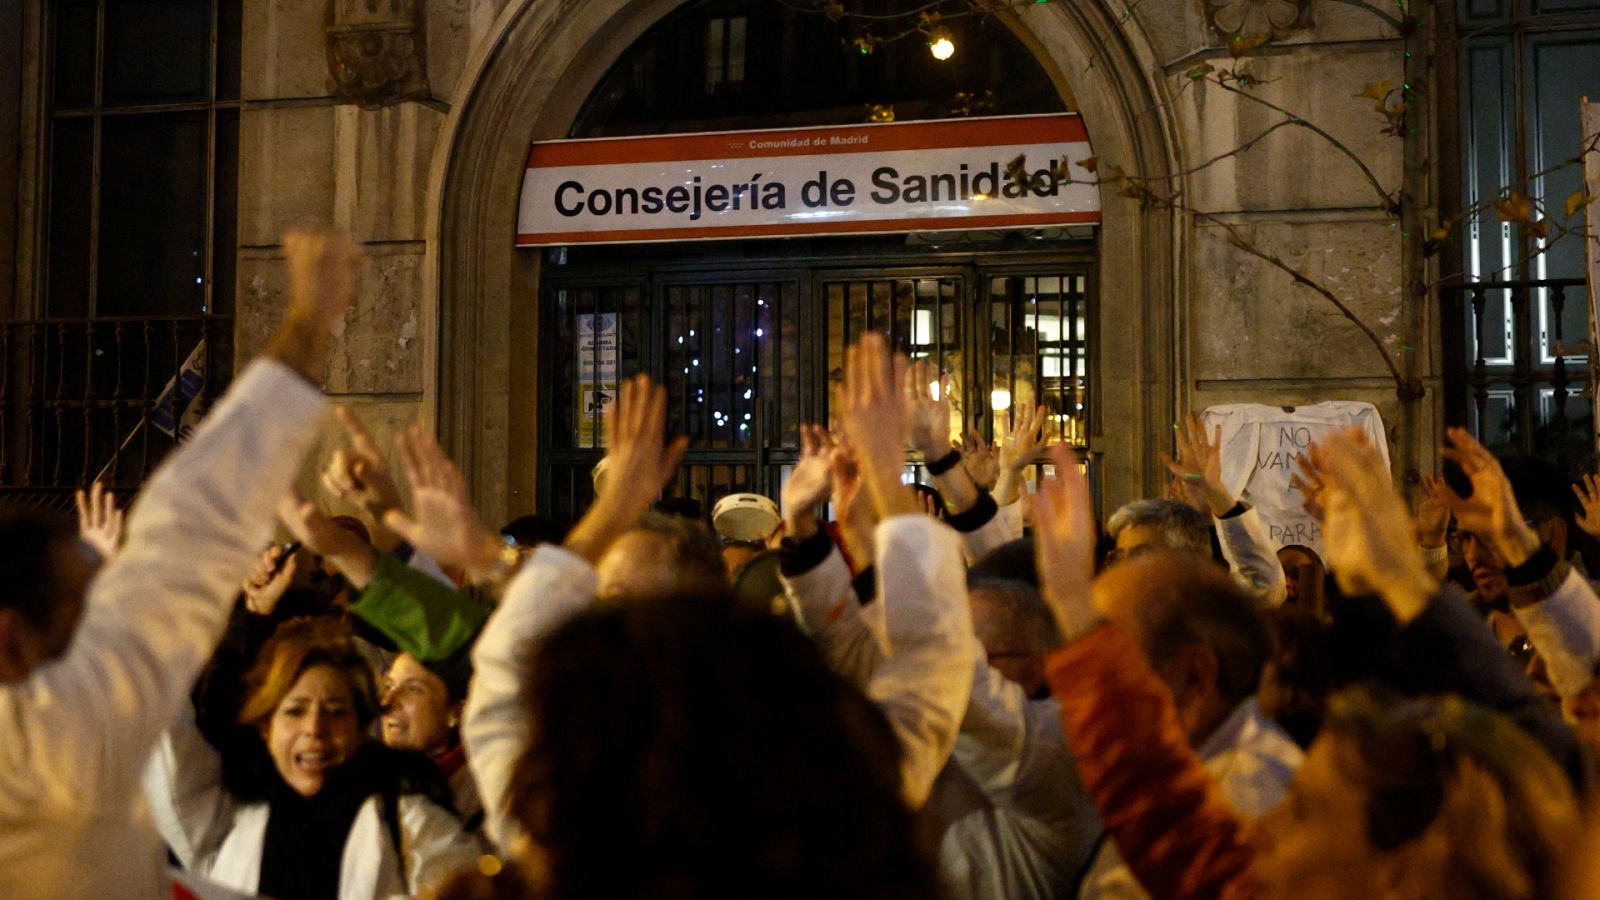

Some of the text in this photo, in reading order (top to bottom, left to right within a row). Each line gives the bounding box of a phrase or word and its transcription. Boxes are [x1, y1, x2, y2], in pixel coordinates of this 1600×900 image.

[749, 135, 869, 149] Comunidad de Madrid
[554, 159, 1059, 220] Consejería de Sanidad
[1279, 427, 1311, 448] NO
[1257, 451, 1297, 470] VAM
[1270, 520, 1323, 543] PARA
